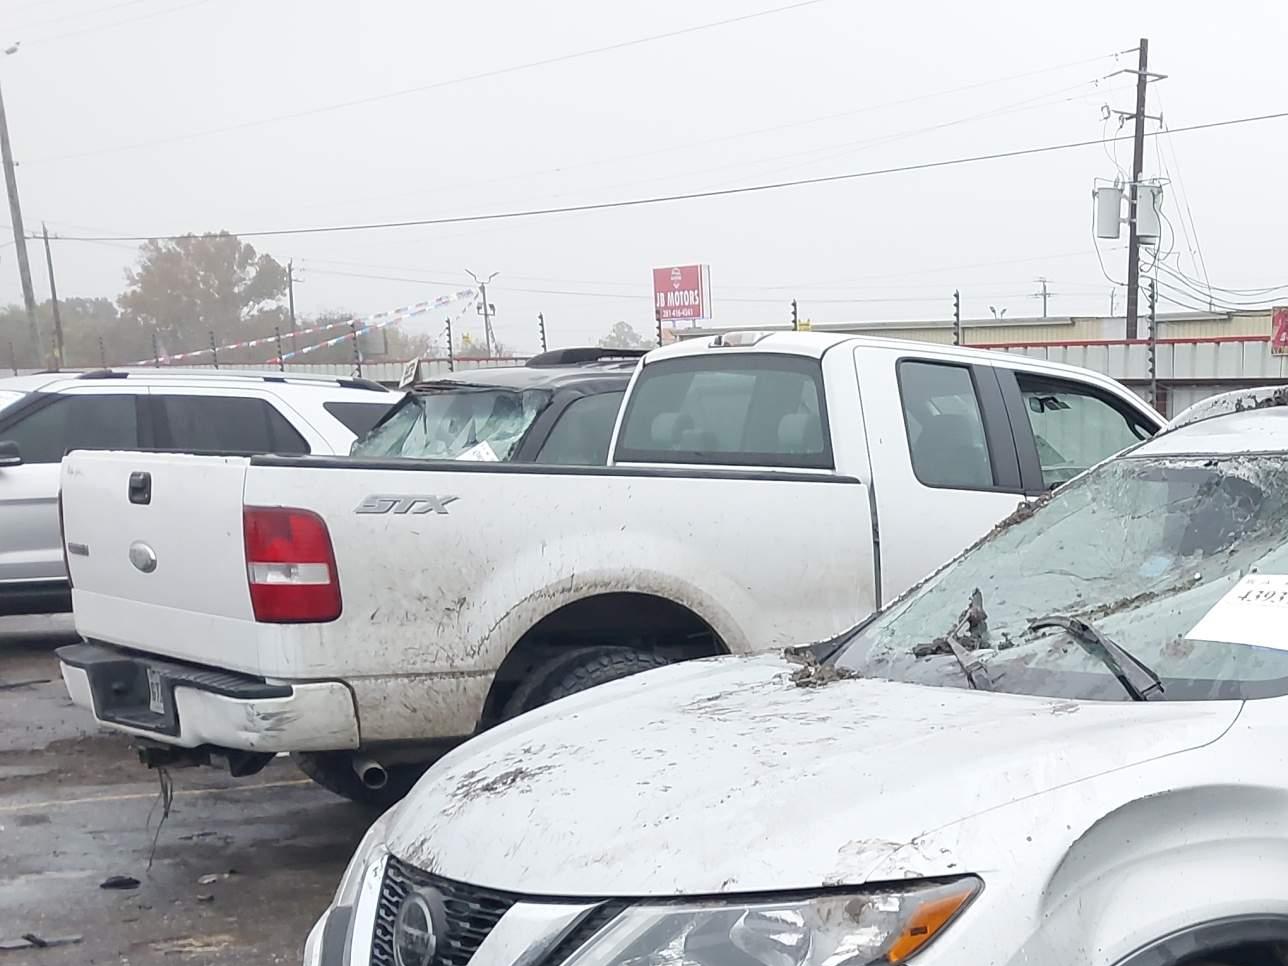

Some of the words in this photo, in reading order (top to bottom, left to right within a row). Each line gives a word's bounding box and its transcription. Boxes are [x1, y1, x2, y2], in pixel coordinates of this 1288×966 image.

[656, 292, 665, 307] JB
[667, 289, 699, 307] MOTORS
[352, 494, 460, 515] STX
